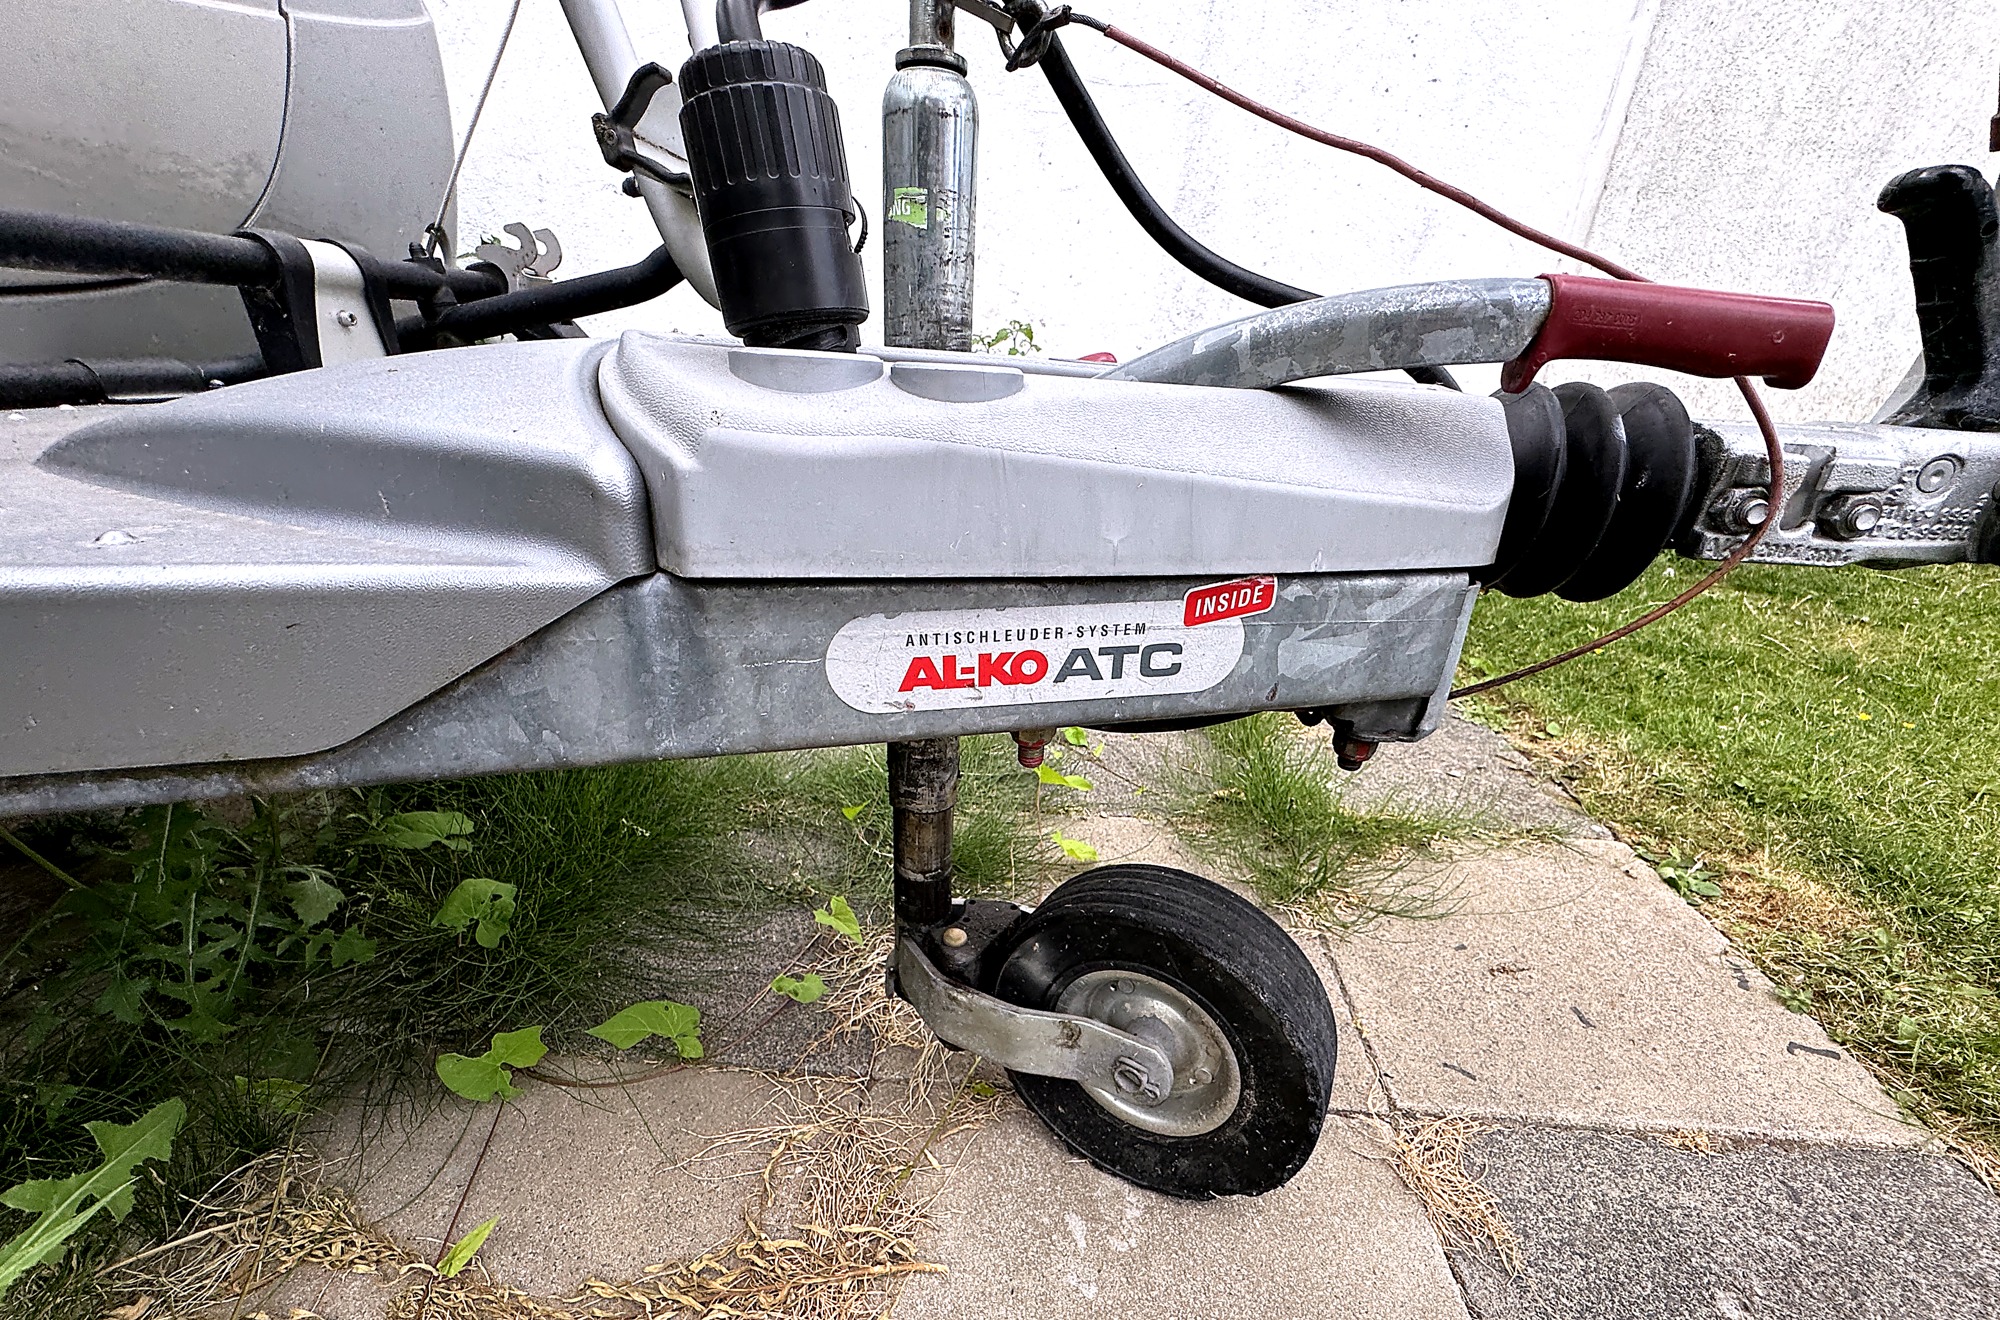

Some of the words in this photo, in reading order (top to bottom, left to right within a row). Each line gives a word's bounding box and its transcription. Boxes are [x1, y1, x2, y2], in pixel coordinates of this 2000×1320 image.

[1194, 584, 1265, 618] INSIDE
[905, 622, 1146, 647] ANTISCHLEUDER-SYSTEM
[898, 649, 1049, 693] AL-KO
[1053, 642, 1184, 684] ATC
